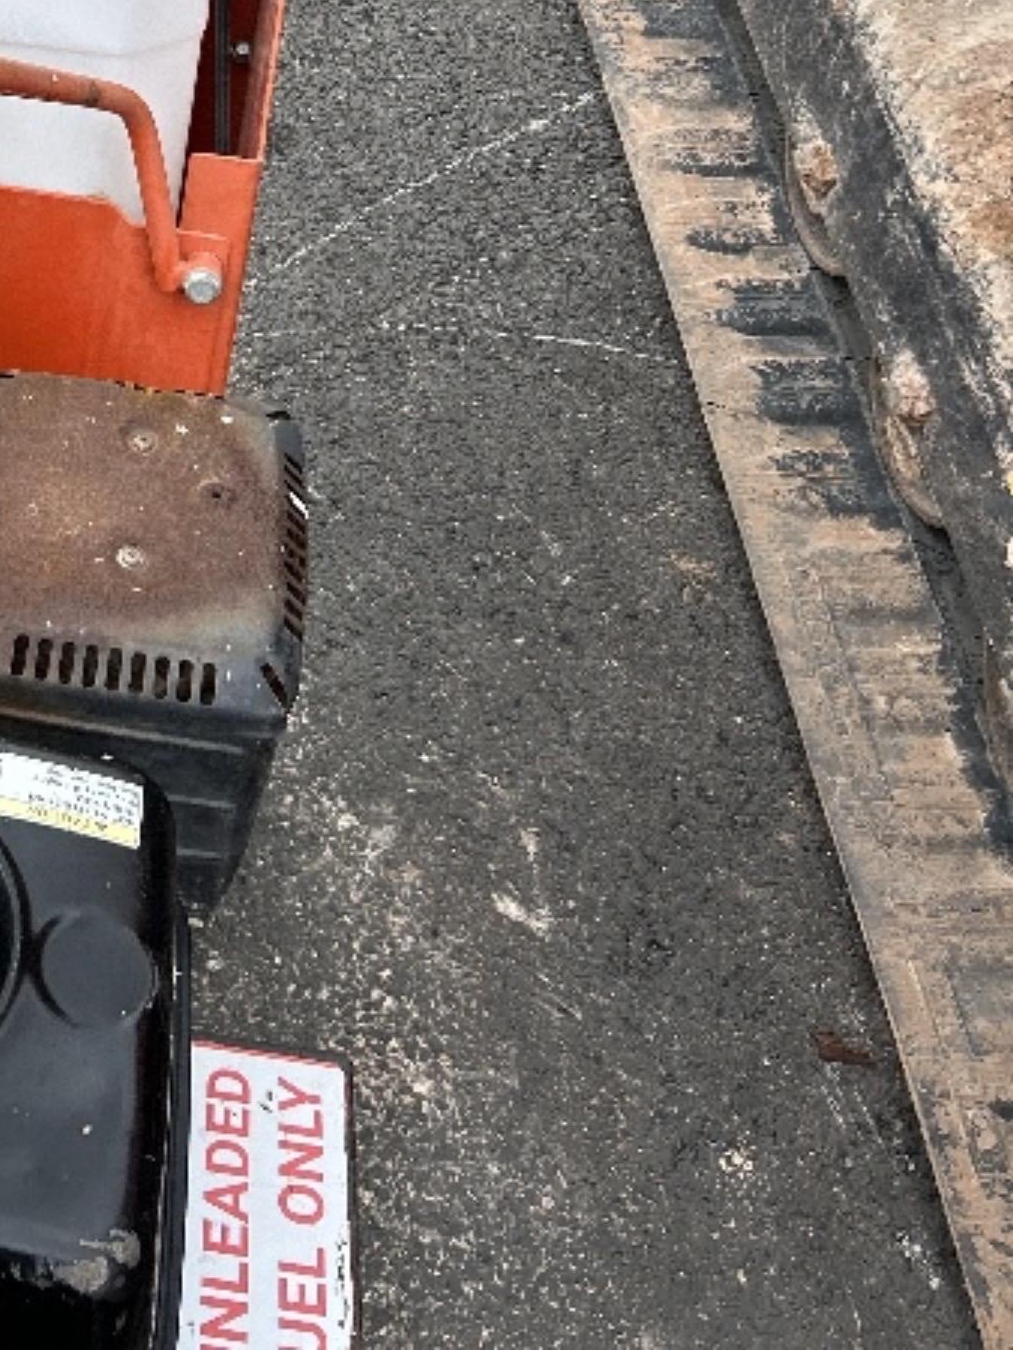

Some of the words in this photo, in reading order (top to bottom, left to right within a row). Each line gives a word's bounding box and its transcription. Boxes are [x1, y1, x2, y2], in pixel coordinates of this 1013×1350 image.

[199, 1066, 251, 1350] NLEADED
[277, 1076, 325, 1227] ONLY
[277, 1247, 327, 1350] UEL
